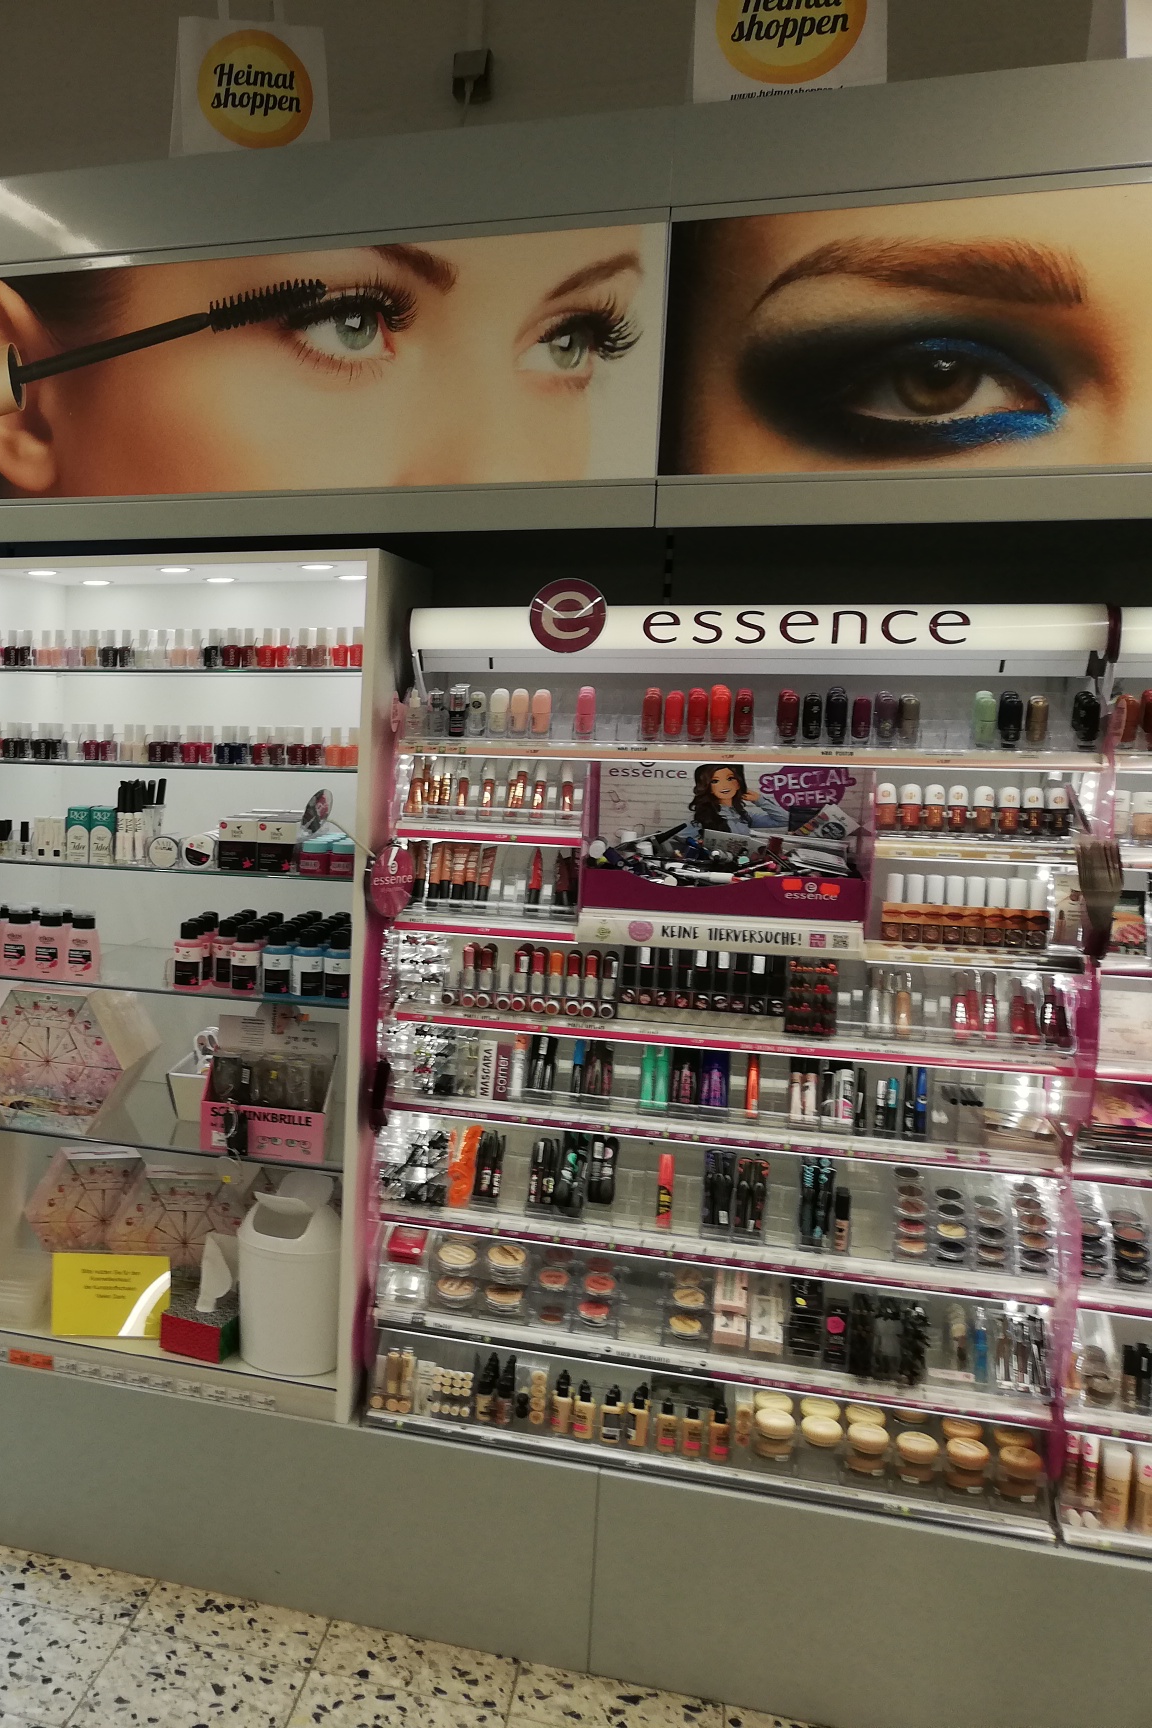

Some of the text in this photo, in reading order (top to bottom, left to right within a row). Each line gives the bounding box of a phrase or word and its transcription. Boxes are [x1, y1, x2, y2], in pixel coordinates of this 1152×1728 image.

[730, 13, 850, 48] shoppen
[213, 63, 295, 90] Heimat
[210, 88, 302, 117] shoppen
[642, 609, 972, 645] essence
[609, 766, 688, 779] essence
[762, 767, 848, 792] SPECIAL
[781, 788, 838, 807] OFFER
[373, 874, 413, 886] essence
[784, 892, 838, 901] essence
[661, 925, 802, 947] KEINE TIERVERSUCHE!
[479, 1048, 493, 1097] MASCARA
[497, 1055, 509, 1093] corner
[210, 1106, 313, 1127] SCINKBRILLE
